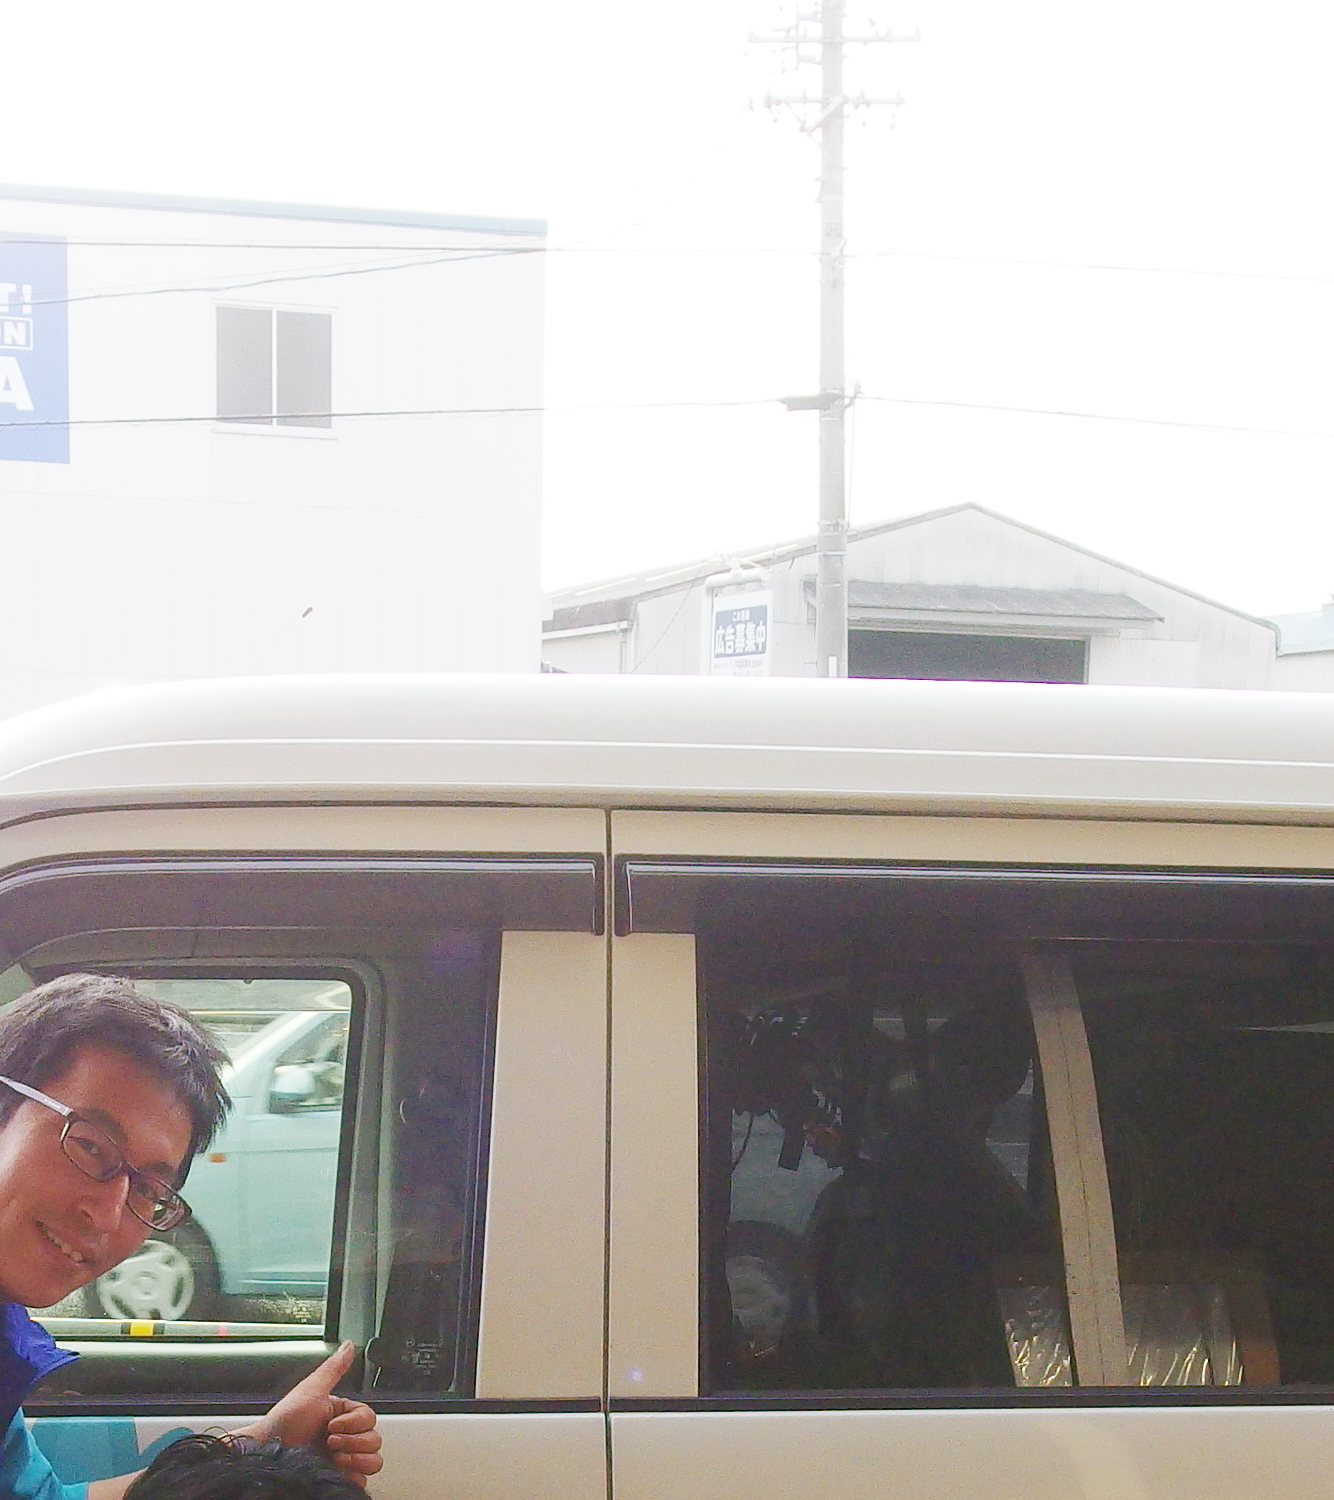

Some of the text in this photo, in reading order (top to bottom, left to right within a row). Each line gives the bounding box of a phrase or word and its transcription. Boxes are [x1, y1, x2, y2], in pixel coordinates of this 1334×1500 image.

[715, 620, 766, 655] 広告募集中
